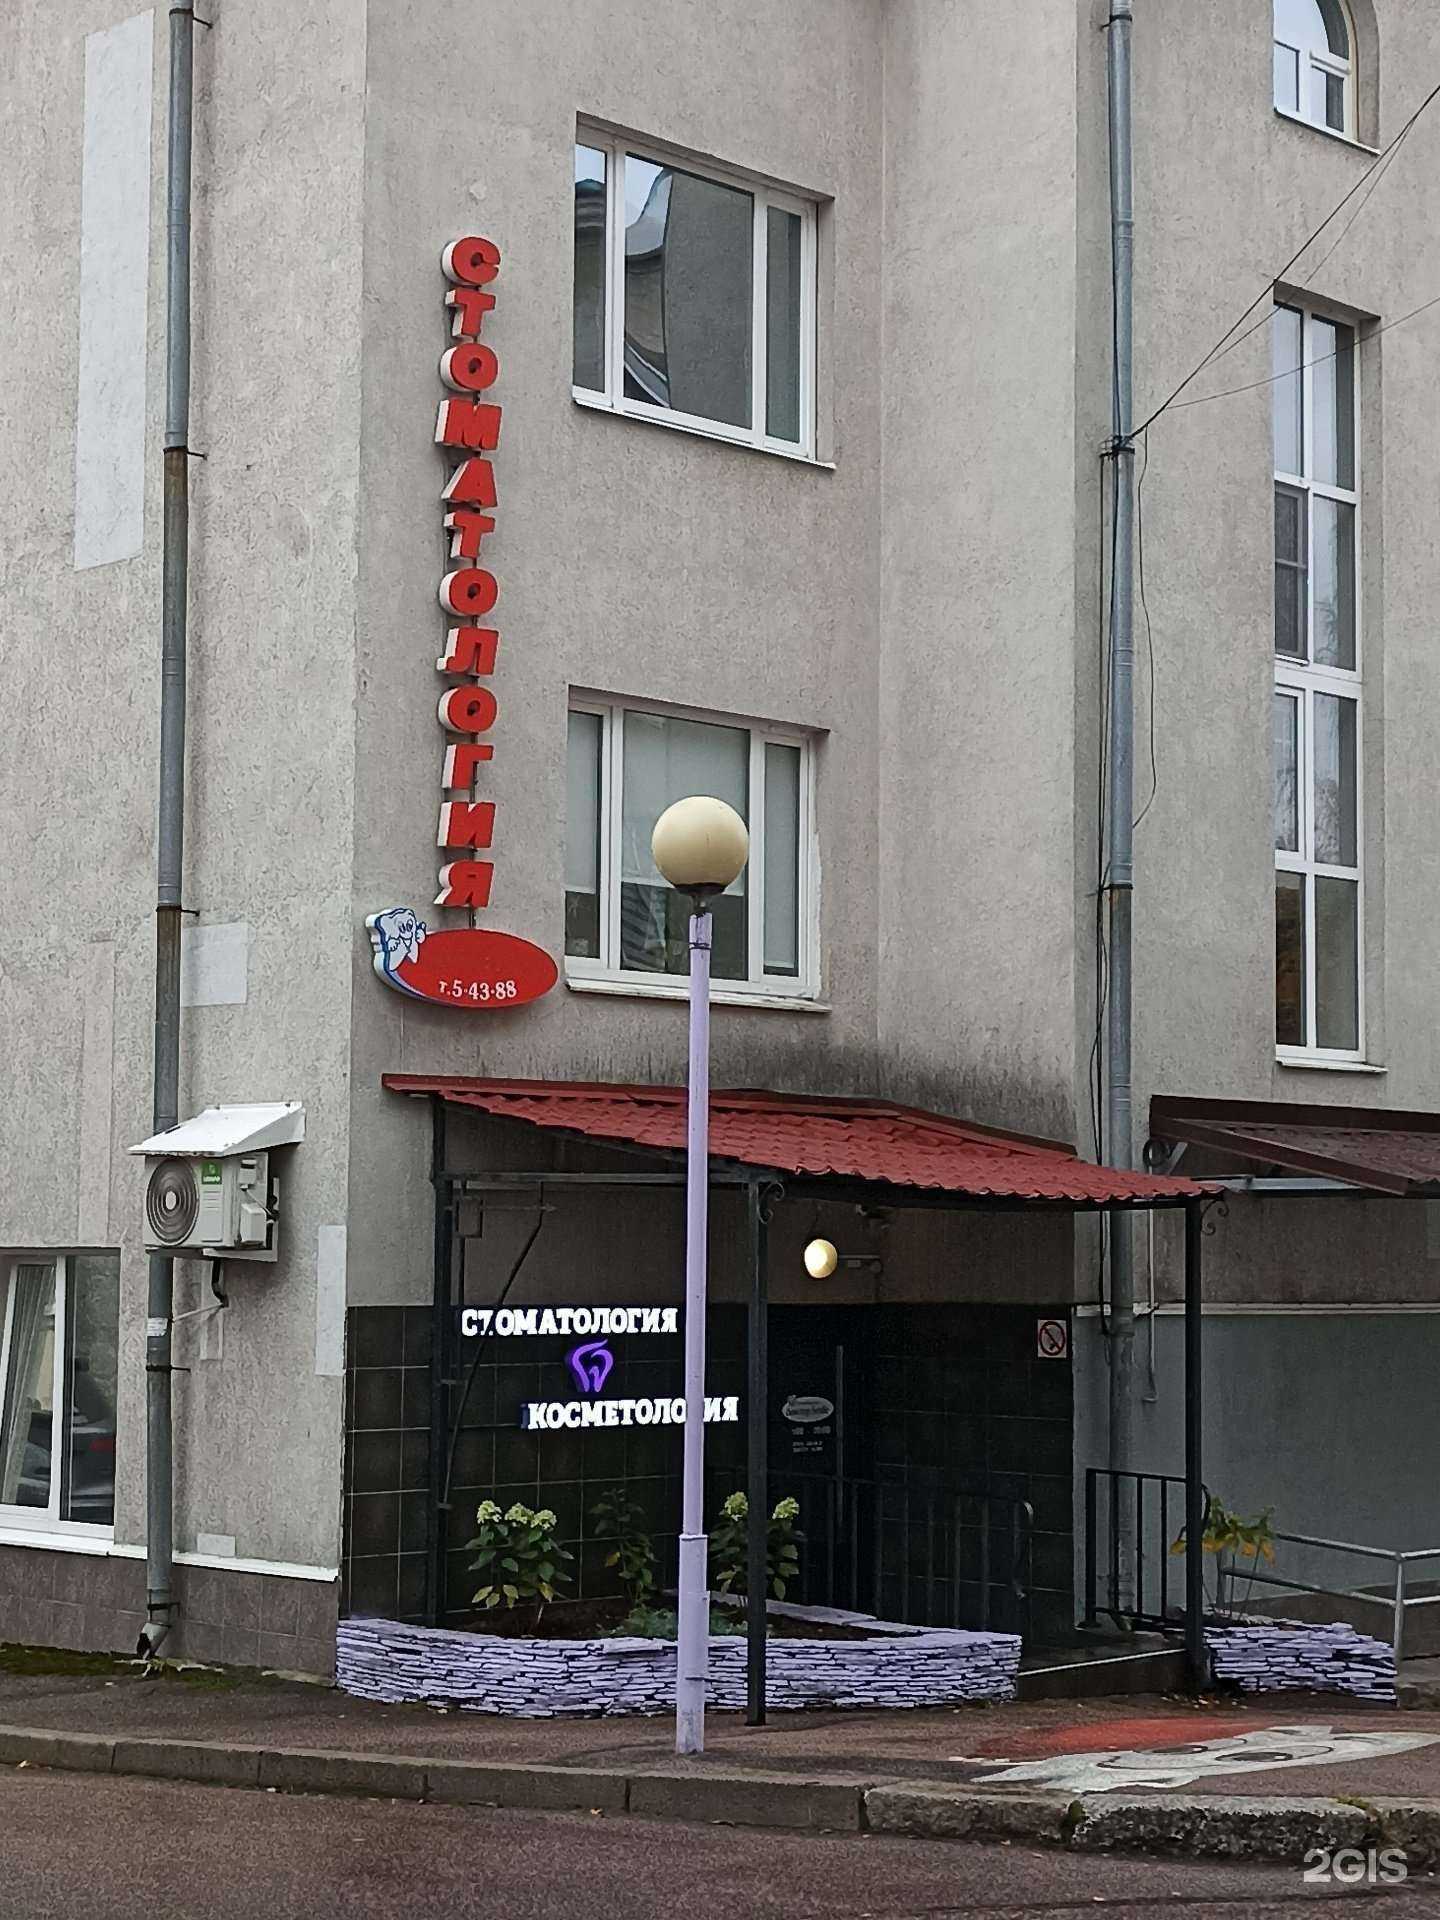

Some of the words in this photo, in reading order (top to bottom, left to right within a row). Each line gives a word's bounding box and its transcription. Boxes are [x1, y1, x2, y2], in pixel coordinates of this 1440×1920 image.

[435, 236, 502, 908] СТОМАТОЛОГИЯ
[461, 1308, 678, 1337] СТОМАТОЛОГИЯ
[526, 1396, 740, 1430] КОСМЕТОЛОИЯ
